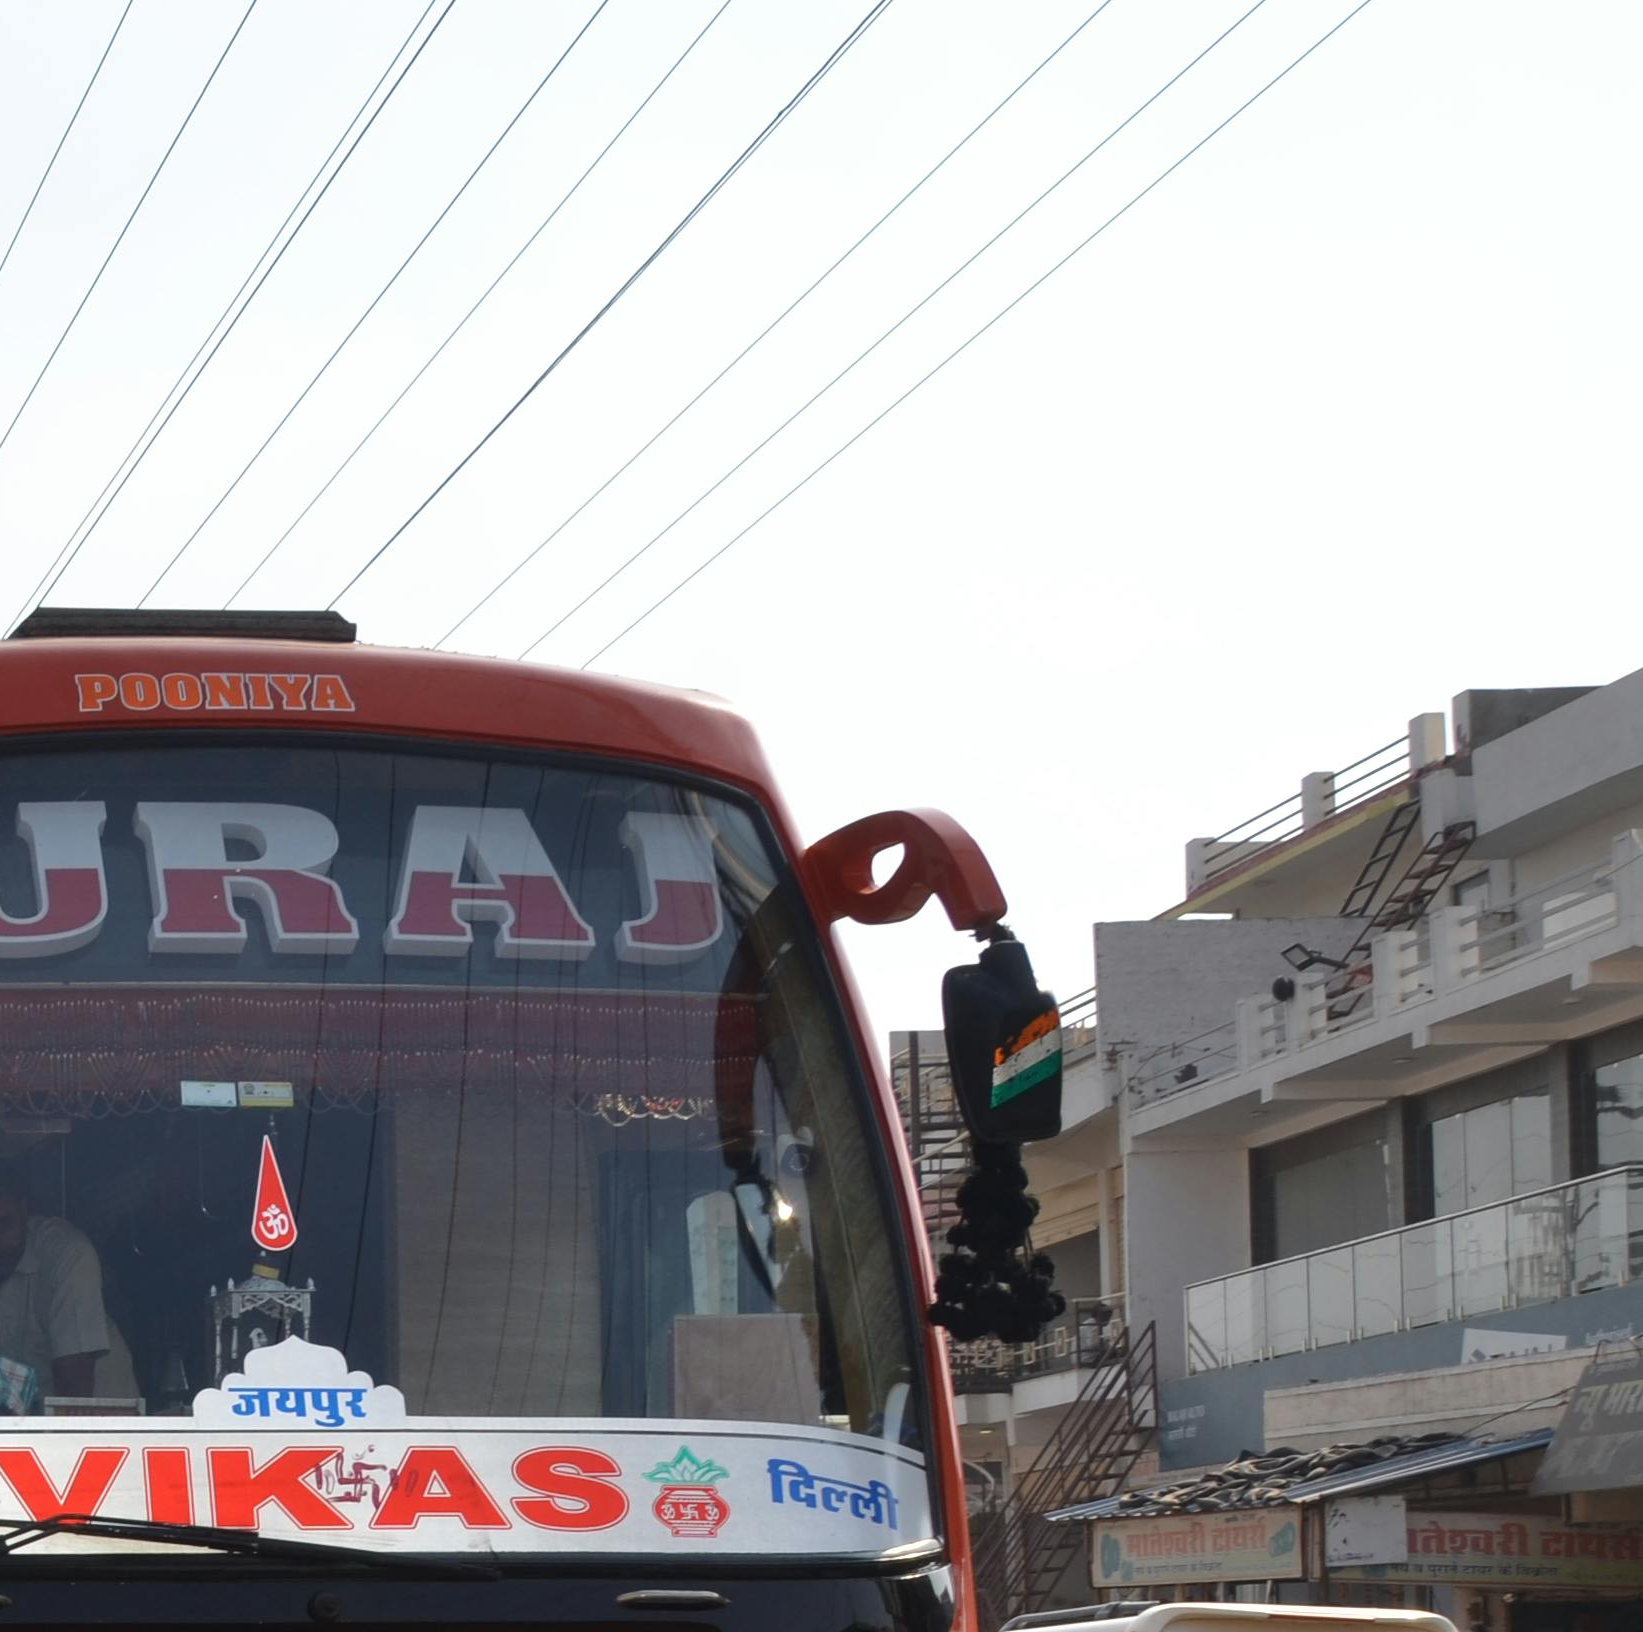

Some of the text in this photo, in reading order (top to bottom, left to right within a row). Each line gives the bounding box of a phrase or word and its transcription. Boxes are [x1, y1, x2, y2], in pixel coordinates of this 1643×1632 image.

[75, 672, 355, 712] POONIYA
[228, 1387, 368, 1427] जयपुर
[767, 1458, 899, 1530] दिल्ली
[1407, 1521, 1530, 1556] ातेश्वरी
